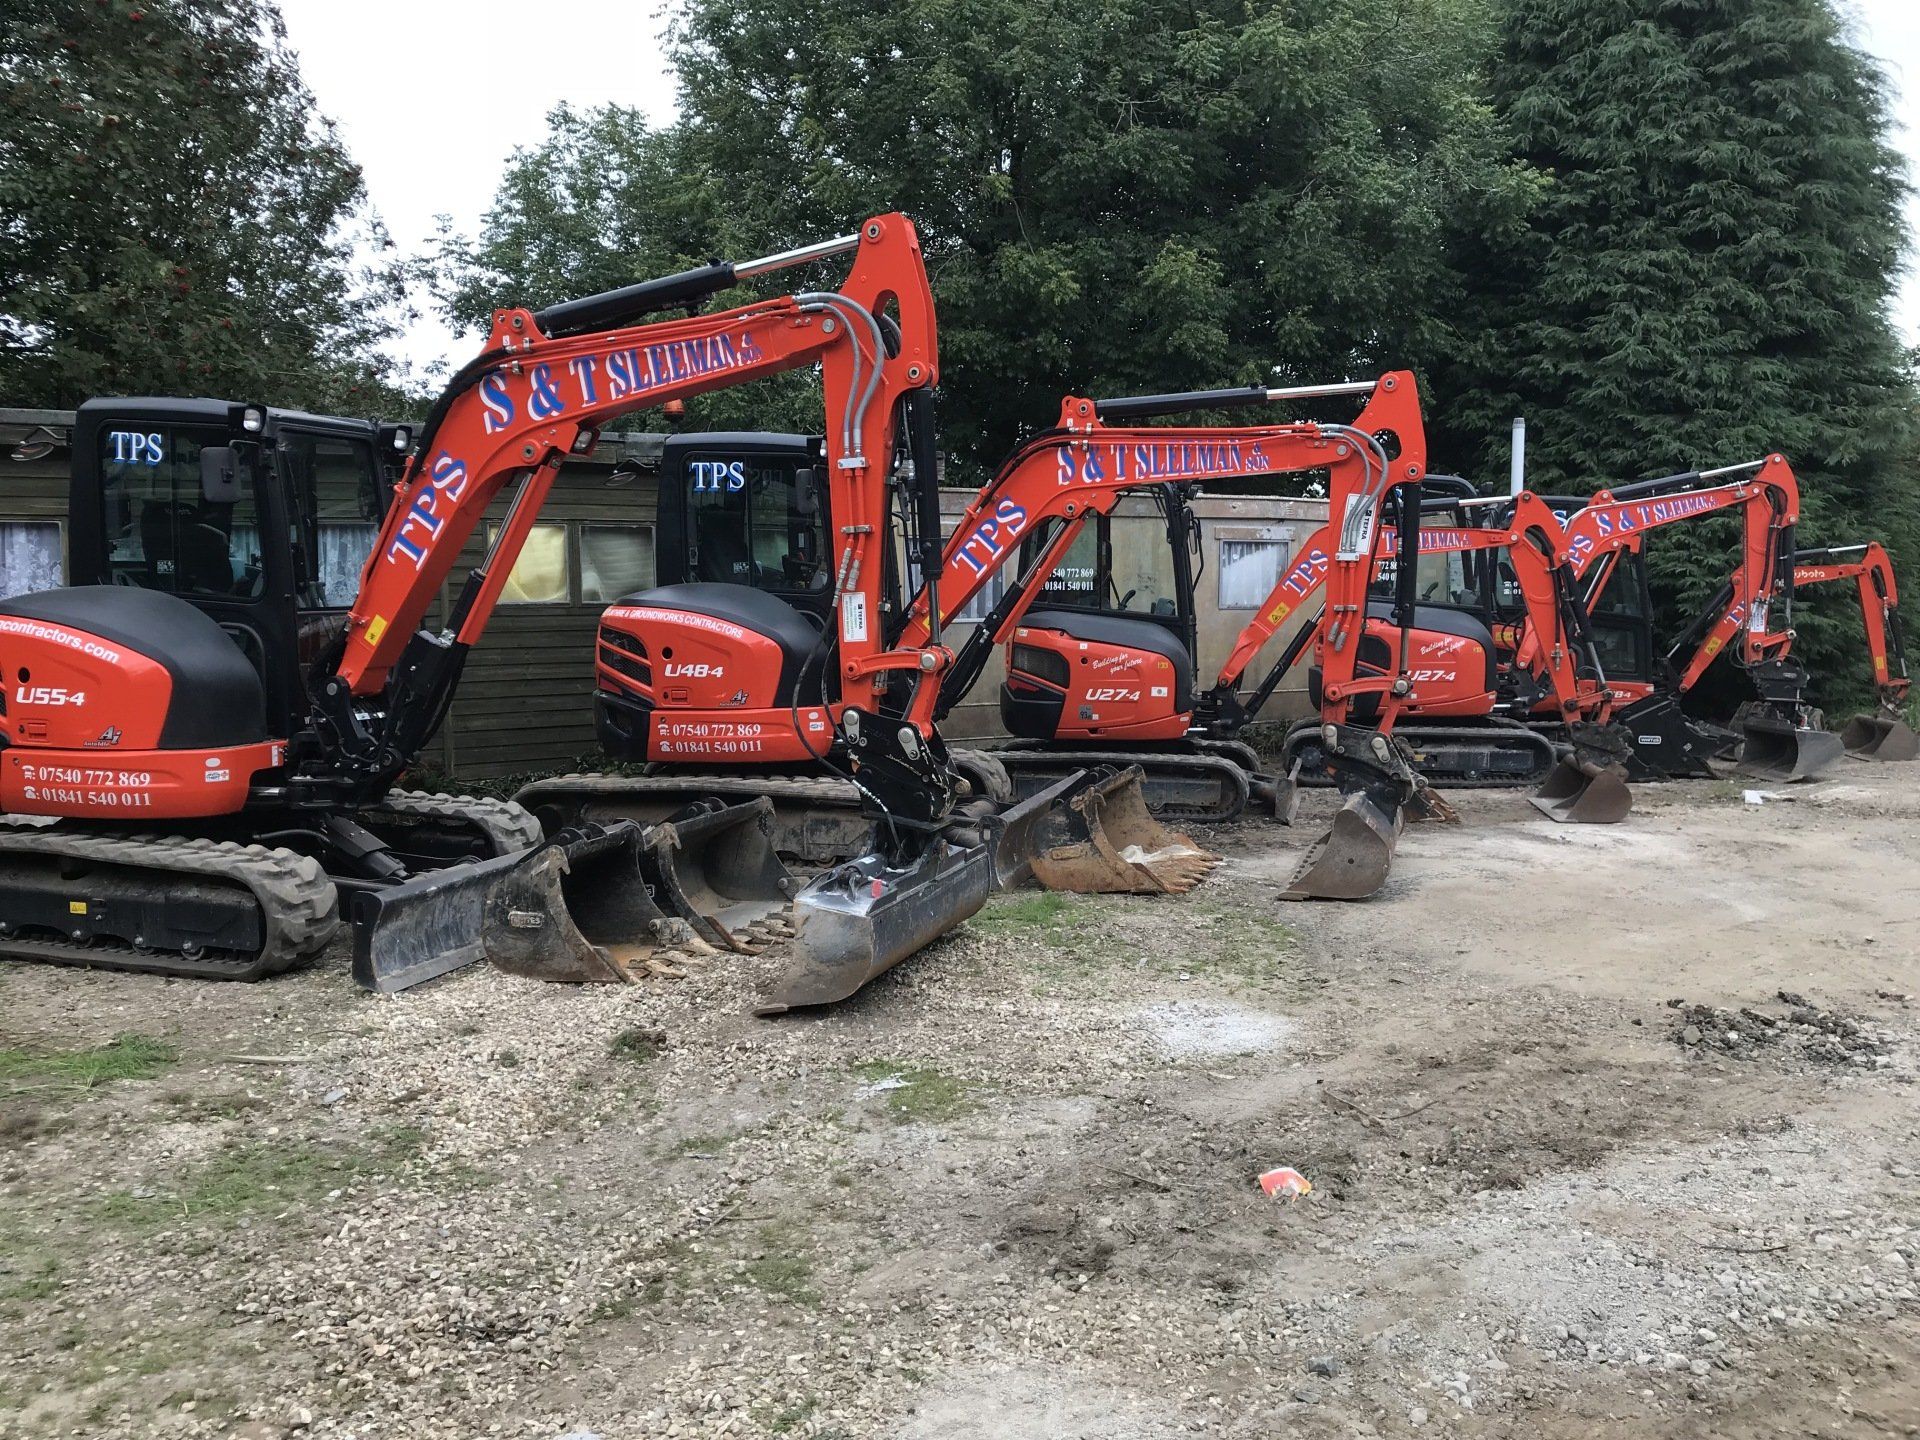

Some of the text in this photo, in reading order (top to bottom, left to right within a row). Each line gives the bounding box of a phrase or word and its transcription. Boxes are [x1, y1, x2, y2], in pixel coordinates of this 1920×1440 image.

[479, 333, 736, 435] S & T SLEEMAN
[109, 431, 163, 466] TPS
[1252, 442, 1262, 455] &
[1056, 440, 1241, 486] S & T SLEEMAN
[1245, 455, 1269, 471] SON
[690, 461, 745, 492] TPS
[387, 450, 467, 571] TPS
[1361, 518, 1370, 540] TEFRA
[1596, 513, 1613, 538] S
[1619, 508, 1636, 532] &
[1637, 505, 1650, 526] T
[952, 495, 1027, 579] TPS
[1419, 532, 1460, 551] EEMAN
[1568, 532, 1594, 576] PS
[1049, 567, 1094, 578] 540 772 869
[1282, 548, 1328, 597] TPS
[1794, 569, 1825, 579] ubota
[1044, 581, 1094, 591] 01841 540 011
[630, 609, 684, 624] GROUNDWORKS
[684, 614, 744, 639] CONTRACTORS
[1092, 652, 1128, 669] Building for
[1110, 658, 1142, 675] your future
[664, 664, 724, 678] U48-4
[16, 687, 85, 706] U55-4
[1085, 688, 1141, 701] U27-4
[98, 725, 122, 746] Ai
[673, 724, 761, 737] 07540 772 869
[675, 740, 762, 753] 01841 540 011
[39, 766, 151, 787] 07540 772 869
[42, 787, 151, 806] 01841 540 011
